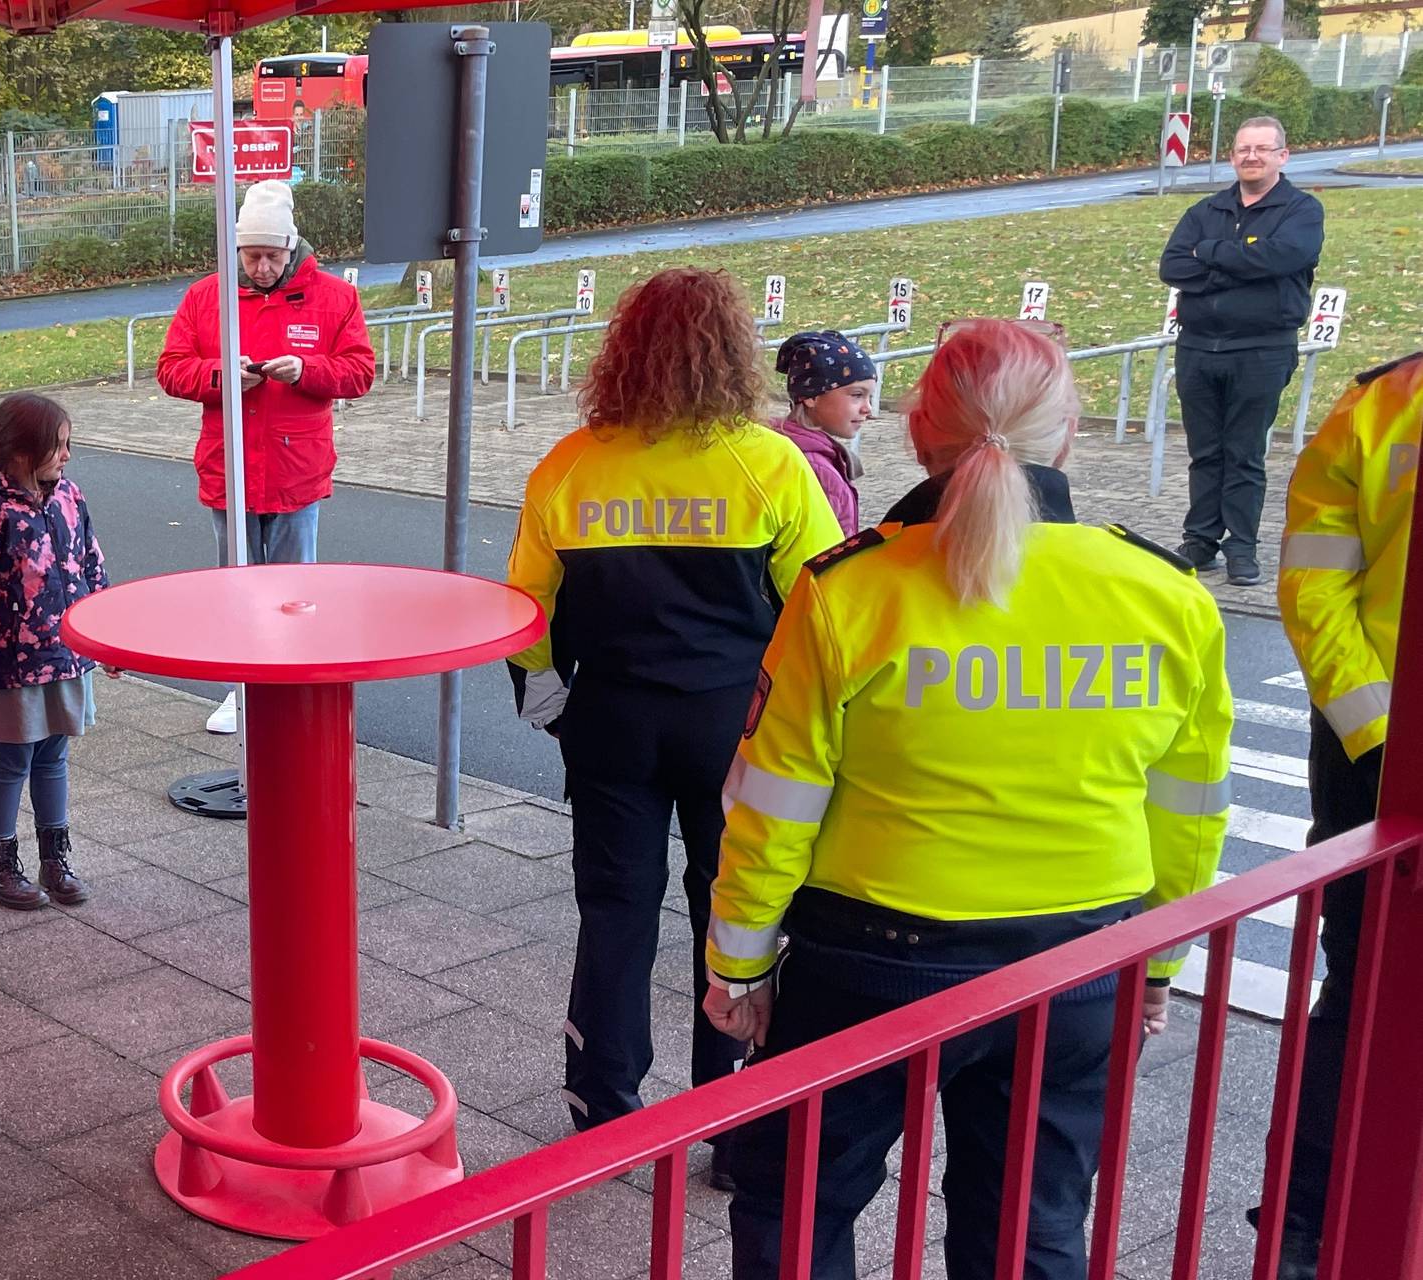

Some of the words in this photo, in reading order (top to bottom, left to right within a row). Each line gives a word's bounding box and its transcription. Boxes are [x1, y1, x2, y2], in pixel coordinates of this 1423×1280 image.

[241, 142, 279, 152] essen
[420, 275, 426, 286] 5
[498, 274, 505, 285] 7
[583, 275, 589, 287] 9
[770, 280, 781, 294] 13
[894, 282, 907, 297] 15
[422, 294, 428, 304] 6
[500, 294, 505, 305] 8
[1027, 288, 1044, 303] 17
[579, 297, 591, 310] 10
[1319, 294, 1339, 312] 21
[768, 304, 780, 318] 14
[892, 308, 906, 323] 16
[1313, 324, 1334, 342] 22
[579, 498, 727, 537] POLIZEI
[904, 644, 1165, 711] POLIZEI
